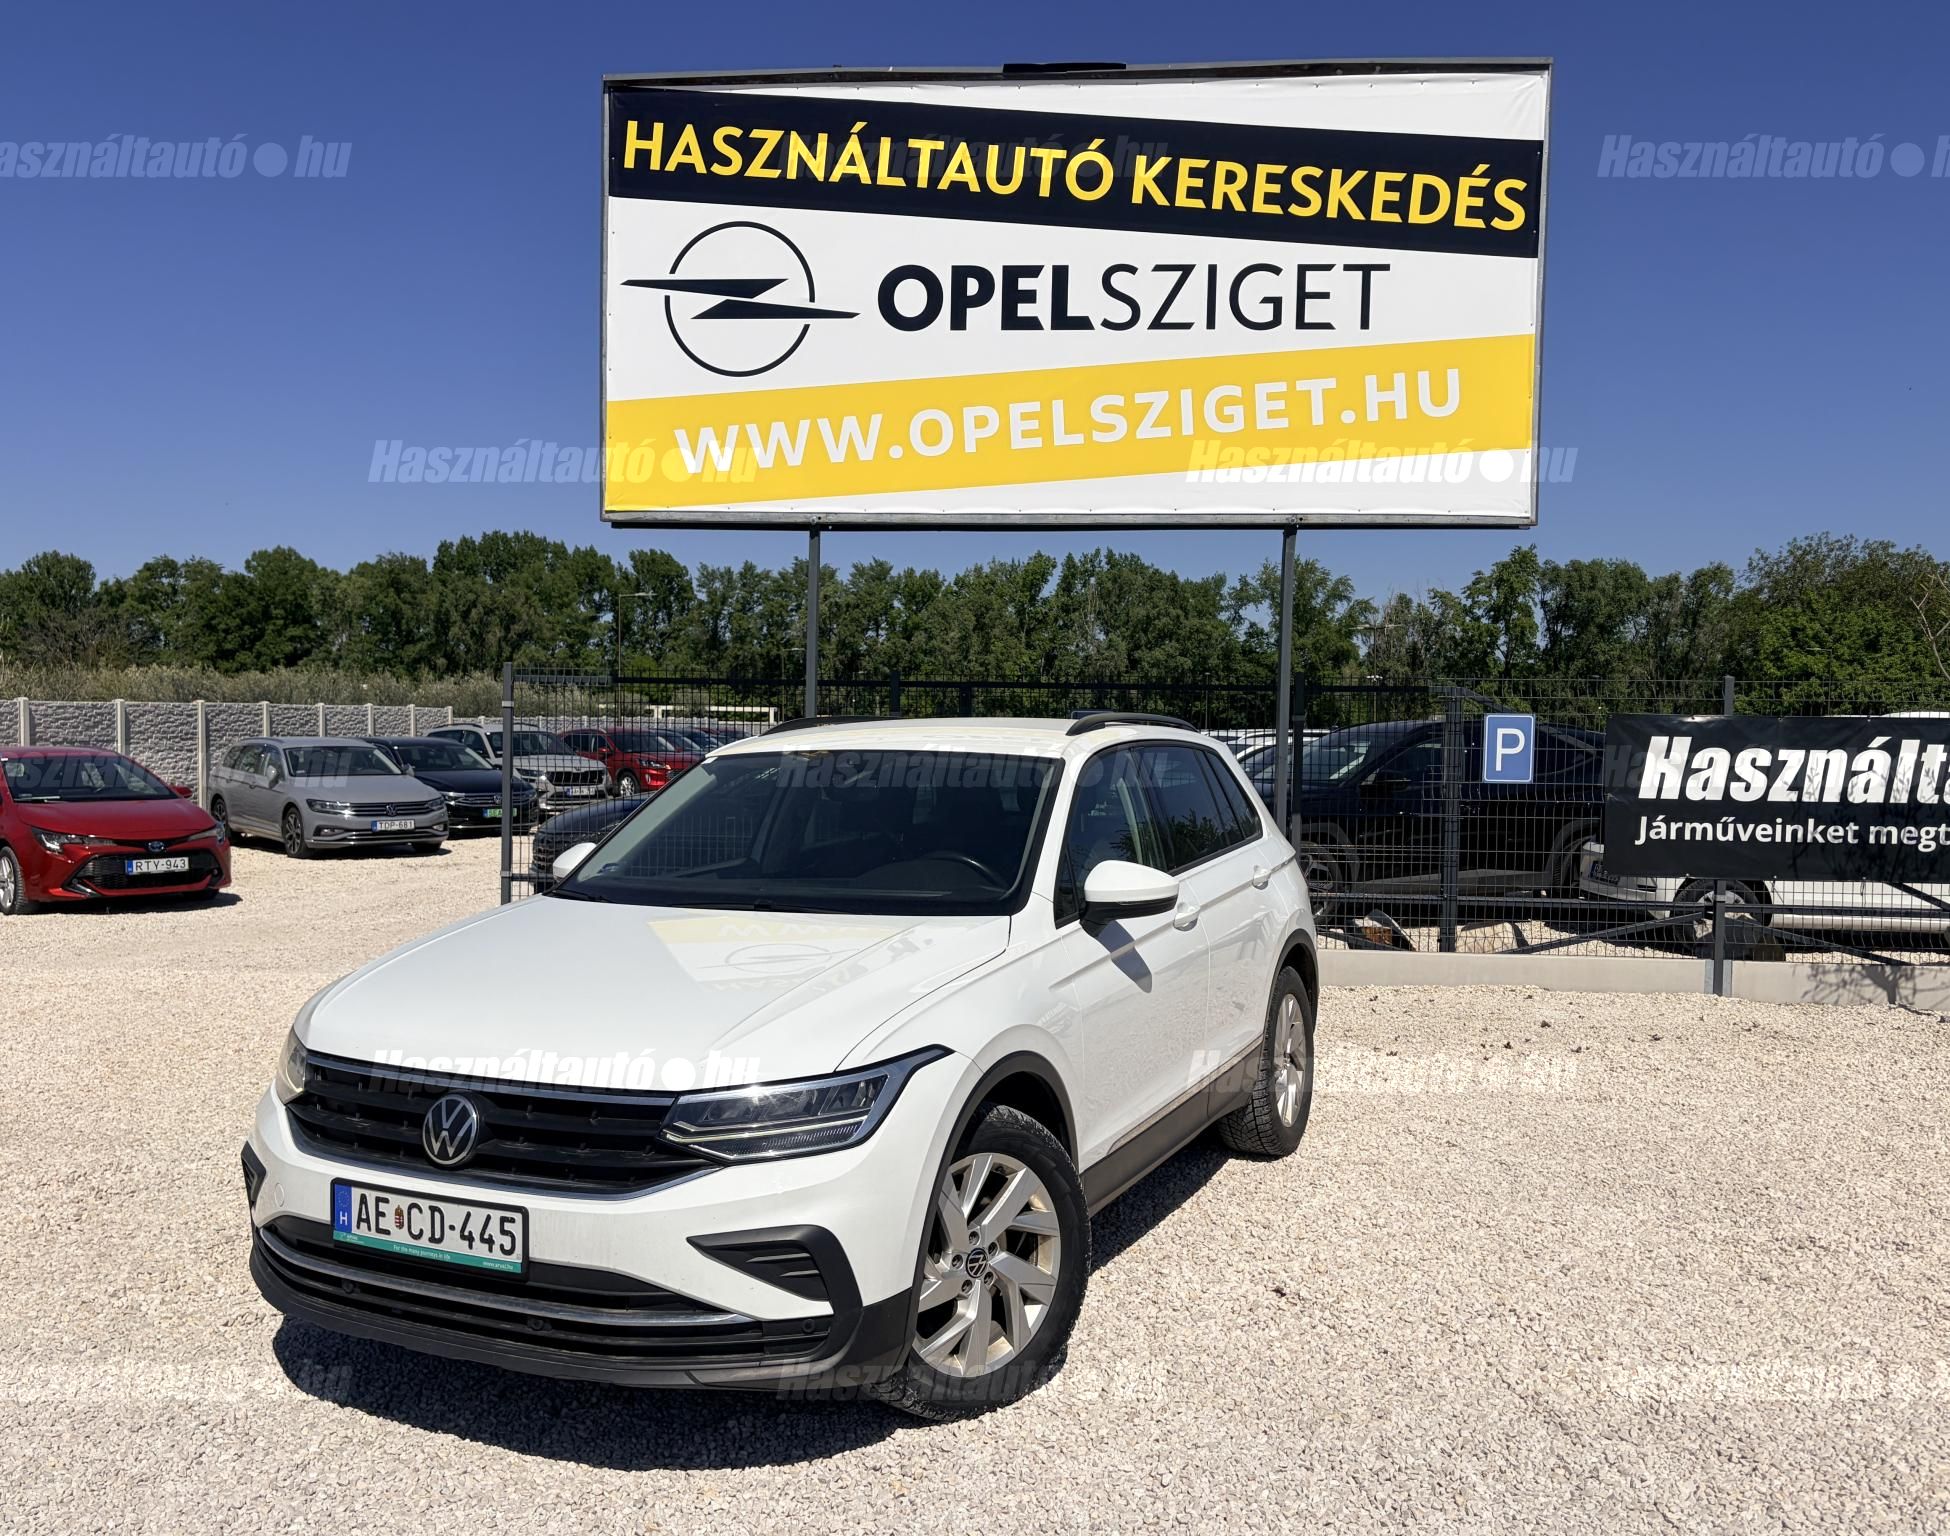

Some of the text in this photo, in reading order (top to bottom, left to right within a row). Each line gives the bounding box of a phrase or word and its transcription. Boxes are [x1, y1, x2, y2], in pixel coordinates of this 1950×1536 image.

[623, 119, 1529, 232] HASZNÁLTAUTÓ KERESKEDÉS
[673, 368, 1461, 474] WWW.OPELSZIGET.HU
[1495, 727, 1525, 771] P
[1638, 735, 1950, 804] Használt
[1634, 814, 1859, 846] Járműveinket
[135, 858, 187, 872] RTY-943
